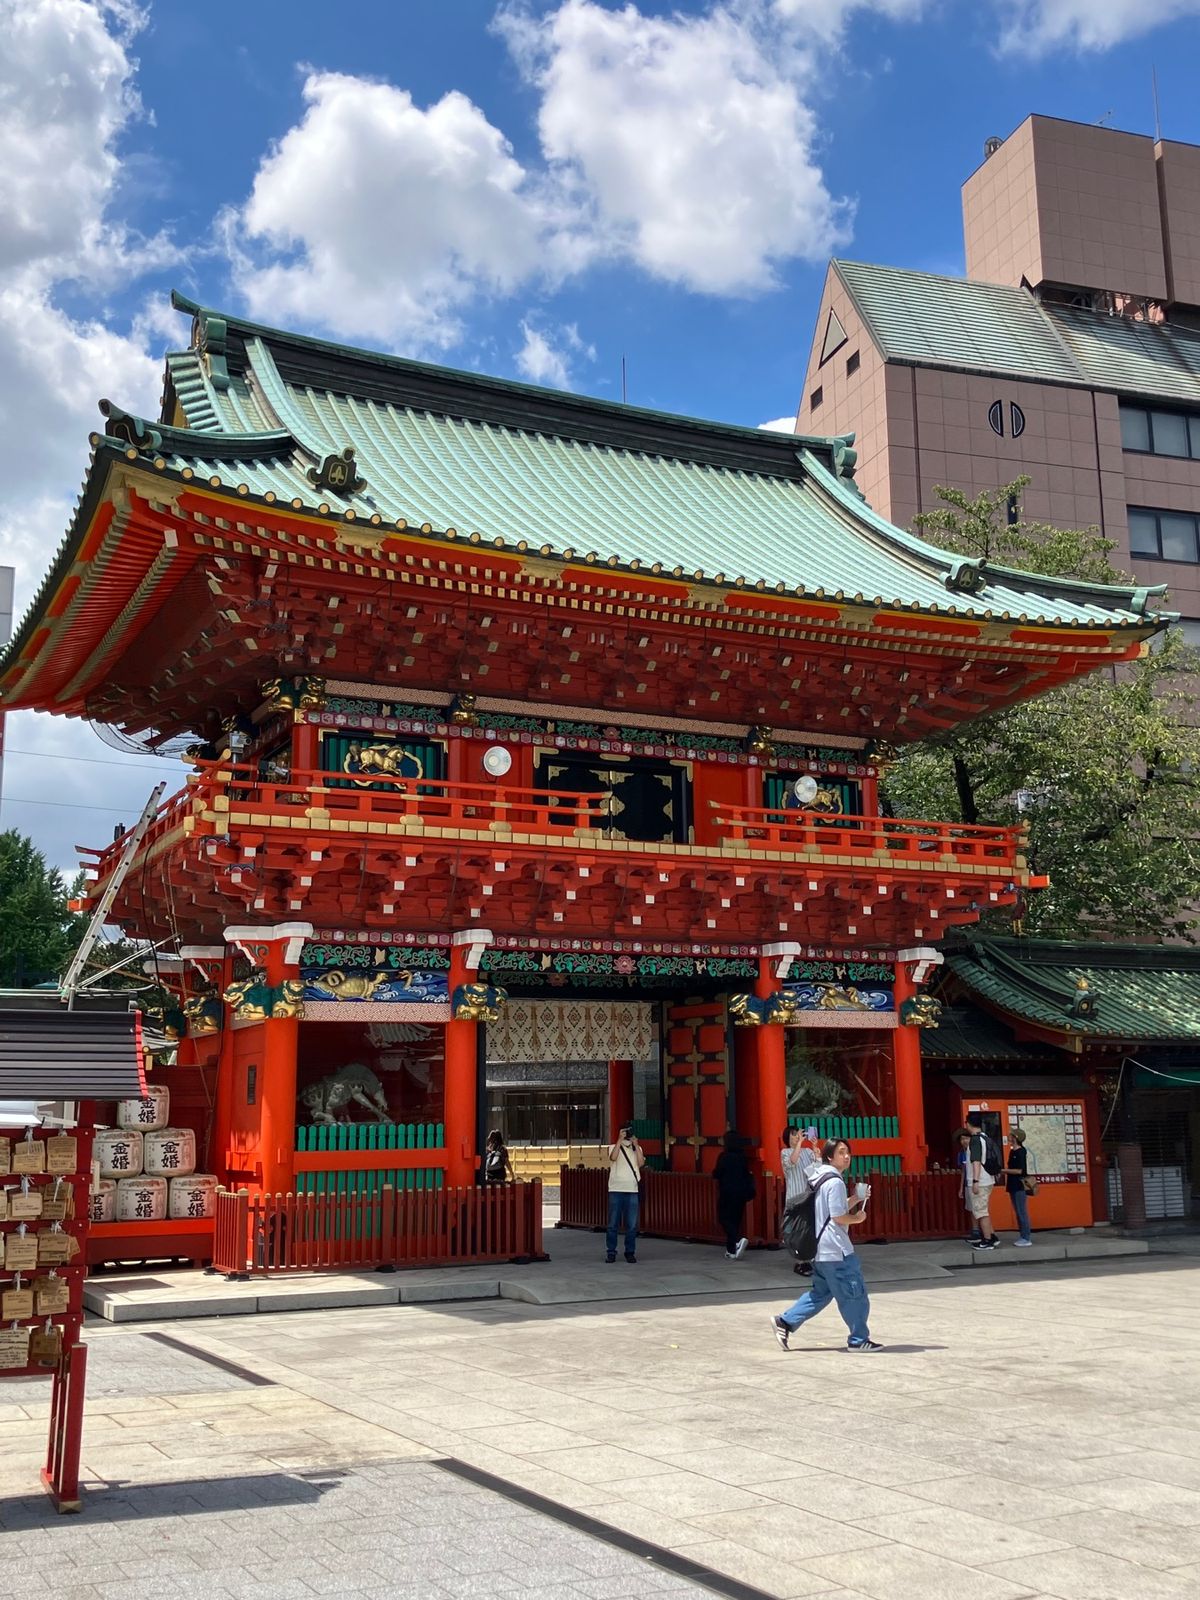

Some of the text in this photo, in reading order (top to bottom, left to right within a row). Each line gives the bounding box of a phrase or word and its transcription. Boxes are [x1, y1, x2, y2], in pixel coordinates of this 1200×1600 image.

[138, 1097, 156, 1123] 金婚
[111, 1142, 130, 1169] 金婚
[161, 1141, 180, 1168] 金婚
[135, 1190, 154, 1217] 金婚
[187, 1190, 206, 1217] 金婚
